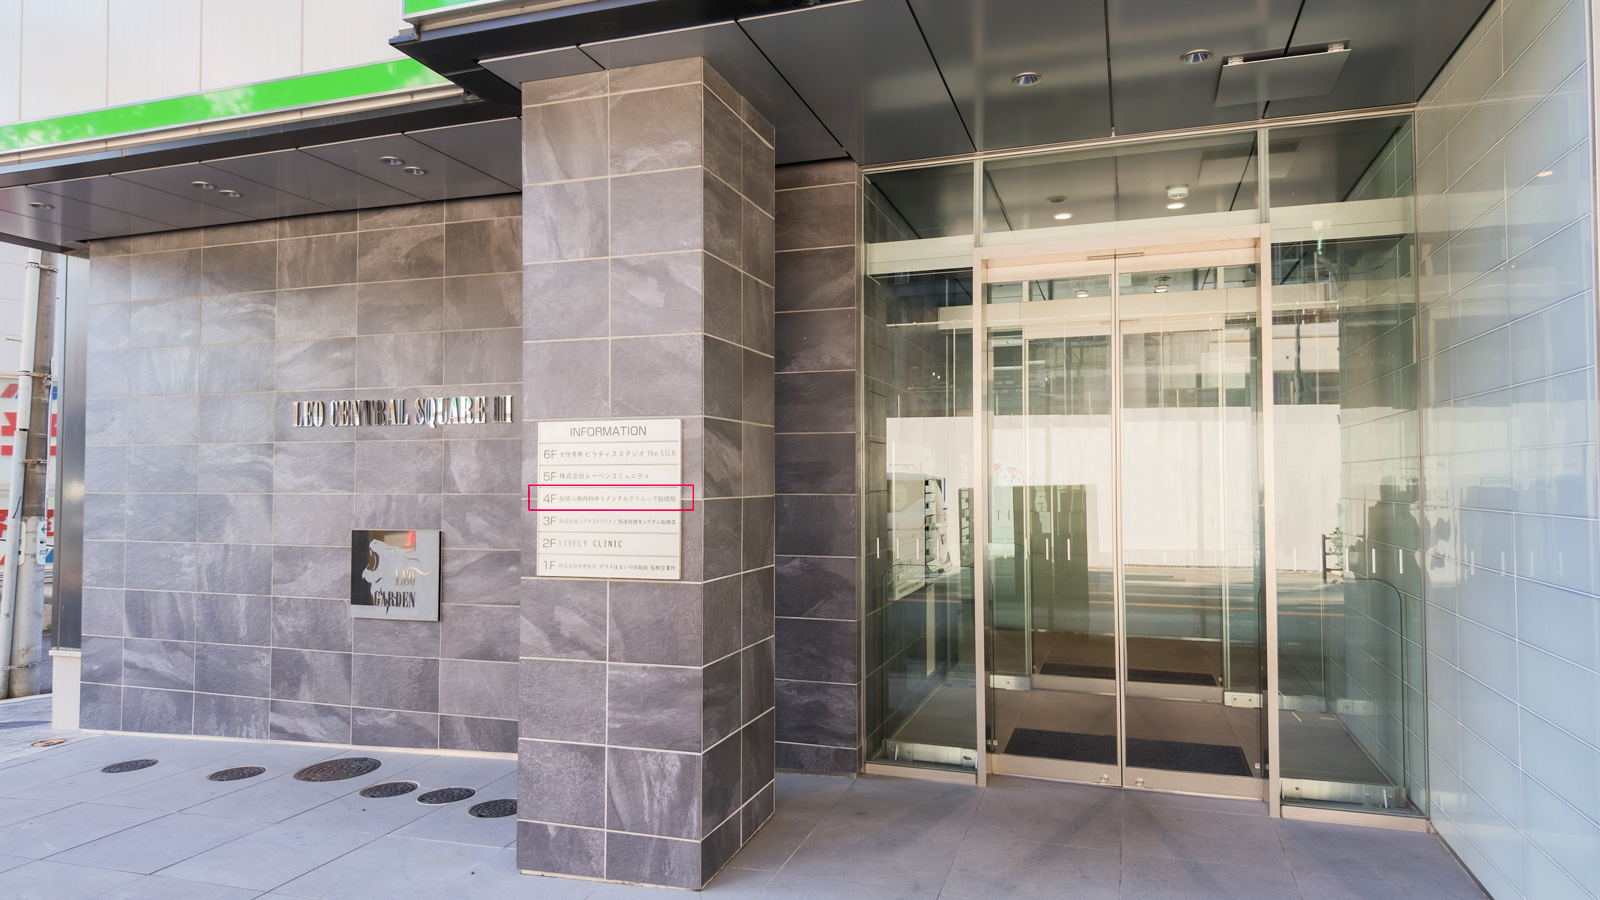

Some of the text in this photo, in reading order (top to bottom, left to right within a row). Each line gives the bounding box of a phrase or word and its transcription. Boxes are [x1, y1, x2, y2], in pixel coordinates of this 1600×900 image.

[292, 401, 325, 427] LEO
[329, 398, 409, 427] CENTRAL
[414, 396, 487, 428] SQUARE
[569, 425, 647, 437] INFORMATION
[543, 449, 557, 459] 6F
[647, 449, 658, 457] the
[660, 449, 676, 457] SILK
[543, 471, 649, 482] 5F 株式会社レーベンコミュニティ
[542, 494, 557, 504] 4F
[542, 516, 557, 526] 3F
[542, 538, 623, 548] 2F LIVELY CLINIC
[543, 560, 556, 570] 1F
[394, 568, 416, 587] LEO
[373, 590, 416, 608] GARDEN
